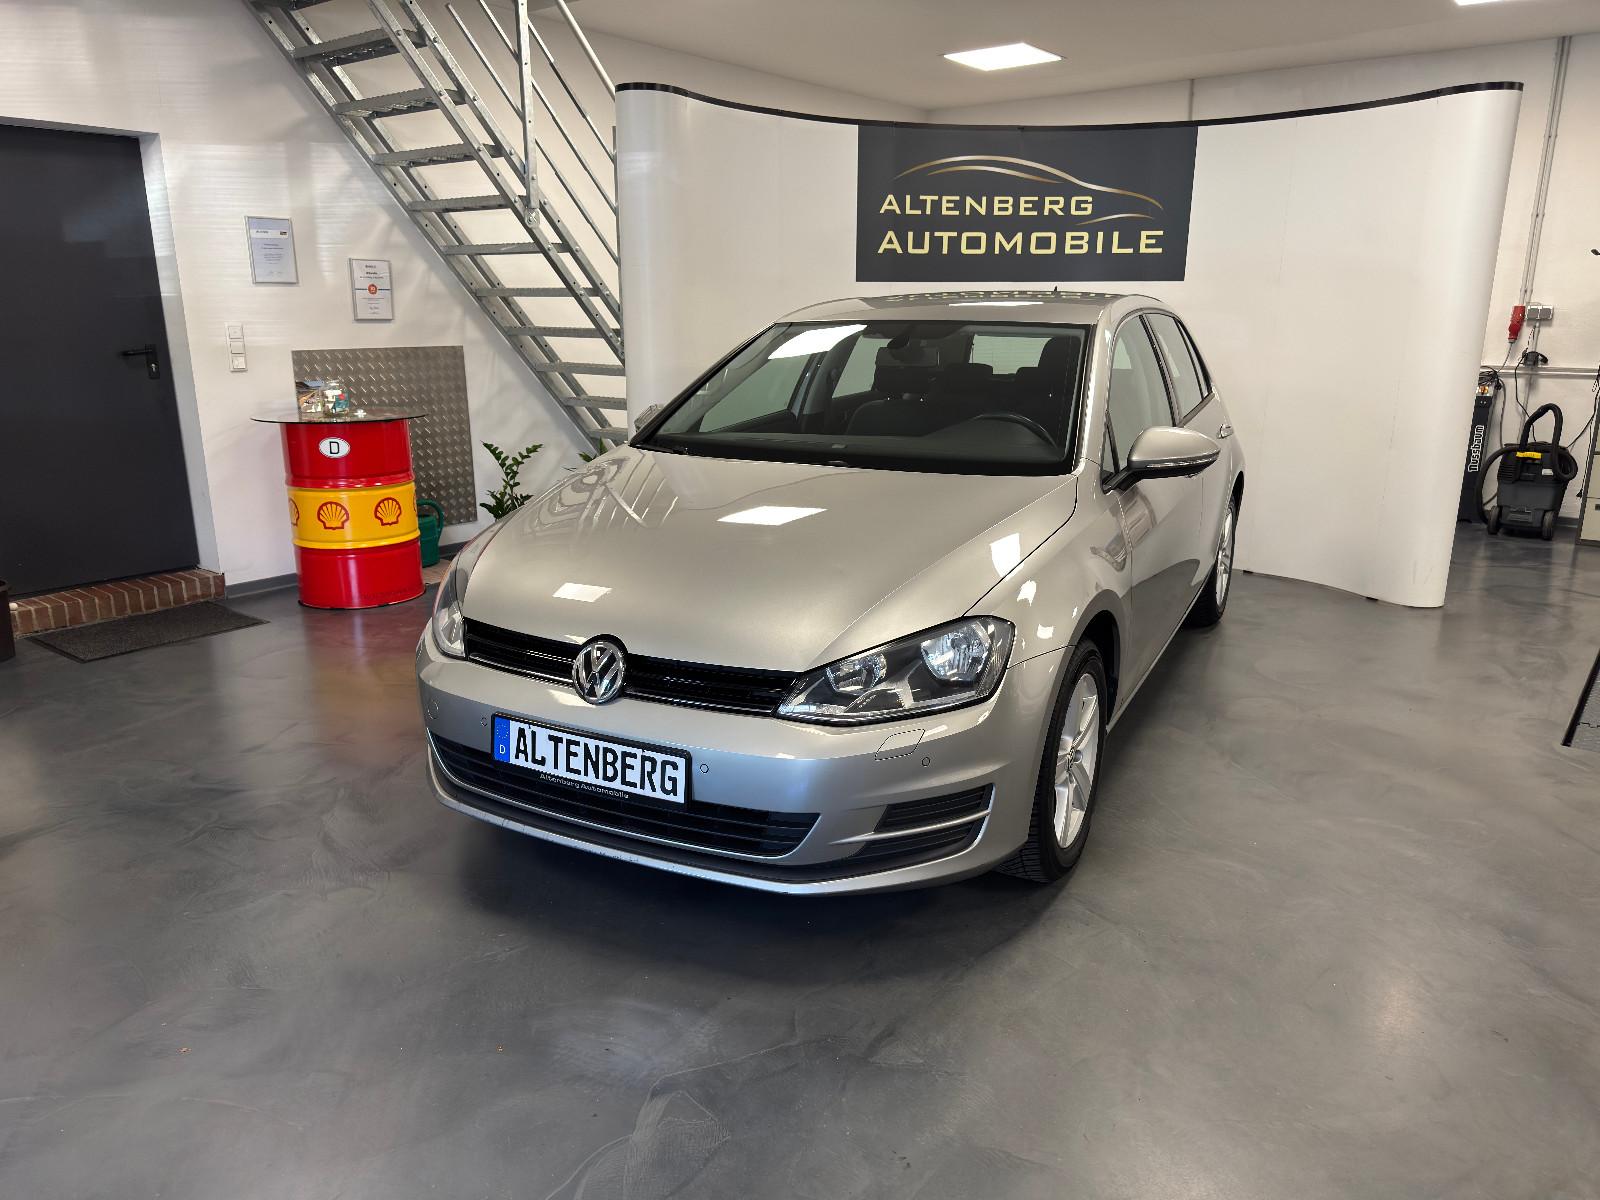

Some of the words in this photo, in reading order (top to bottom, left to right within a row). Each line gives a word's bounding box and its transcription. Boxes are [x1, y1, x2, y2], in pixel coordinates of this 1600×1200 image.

[879, 194, 1093, 216] ALTENBERG
[877, 230, 1164, 255] AUTOMOBILE
[330, 441, 340, 454] D
[499, 744, 506, 754] D
[514, 726, 679, 797] ALTENBERG
[540, 773, 580, 789] Altenberg
[580, 783, 629, 799] Automobile
